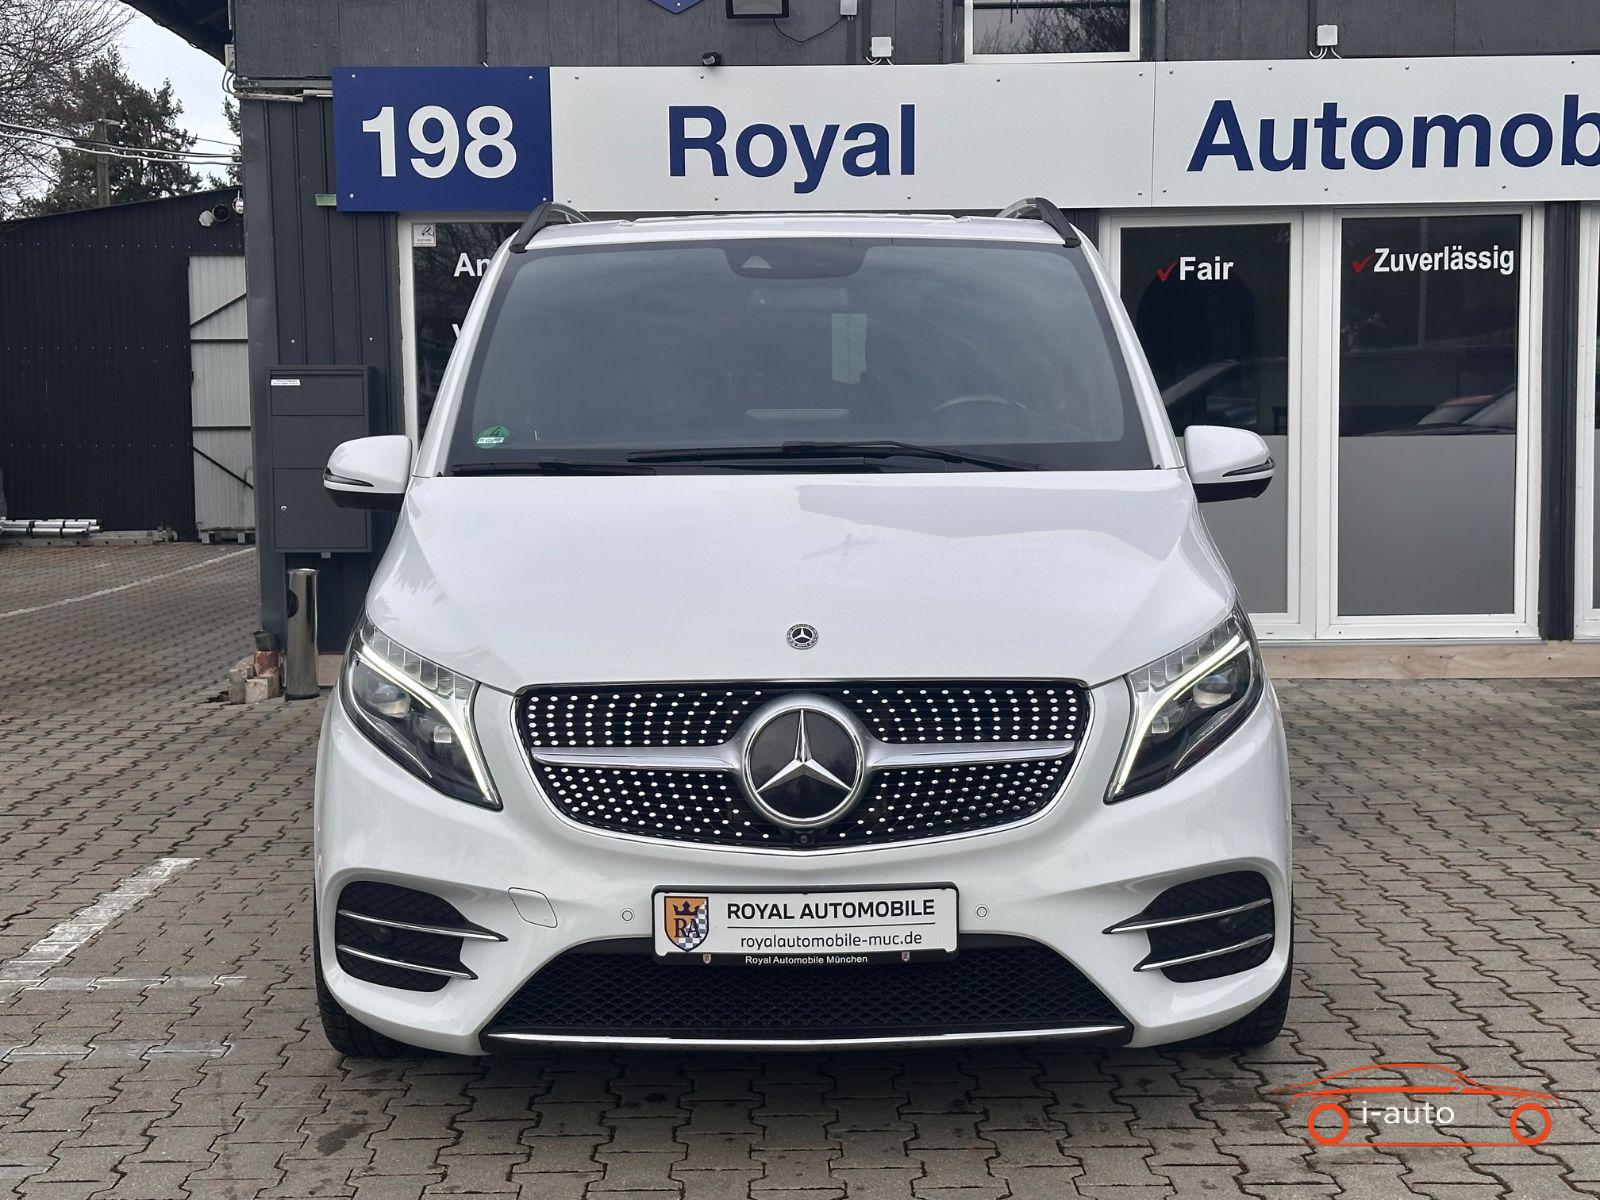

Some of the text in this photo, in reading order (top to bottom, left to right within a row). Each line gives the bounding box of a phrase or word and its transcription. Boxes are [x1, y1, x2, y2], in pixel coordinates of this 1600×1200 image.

[362, 105, 517, 179] 198
[668, 104, 916, 194] Royal
[1179, 256, 1235, 281] Fair
[1373, 245, 1515, 275] Zuverlässig
[727, 899, 935, 920] ROYAL AUTOMOBILE
[674, 918, 701, 938] RA
[741, 931, 922, 950] royalautomobile-muc.de
[745, 954, 868, 964] Royal Automobile München
